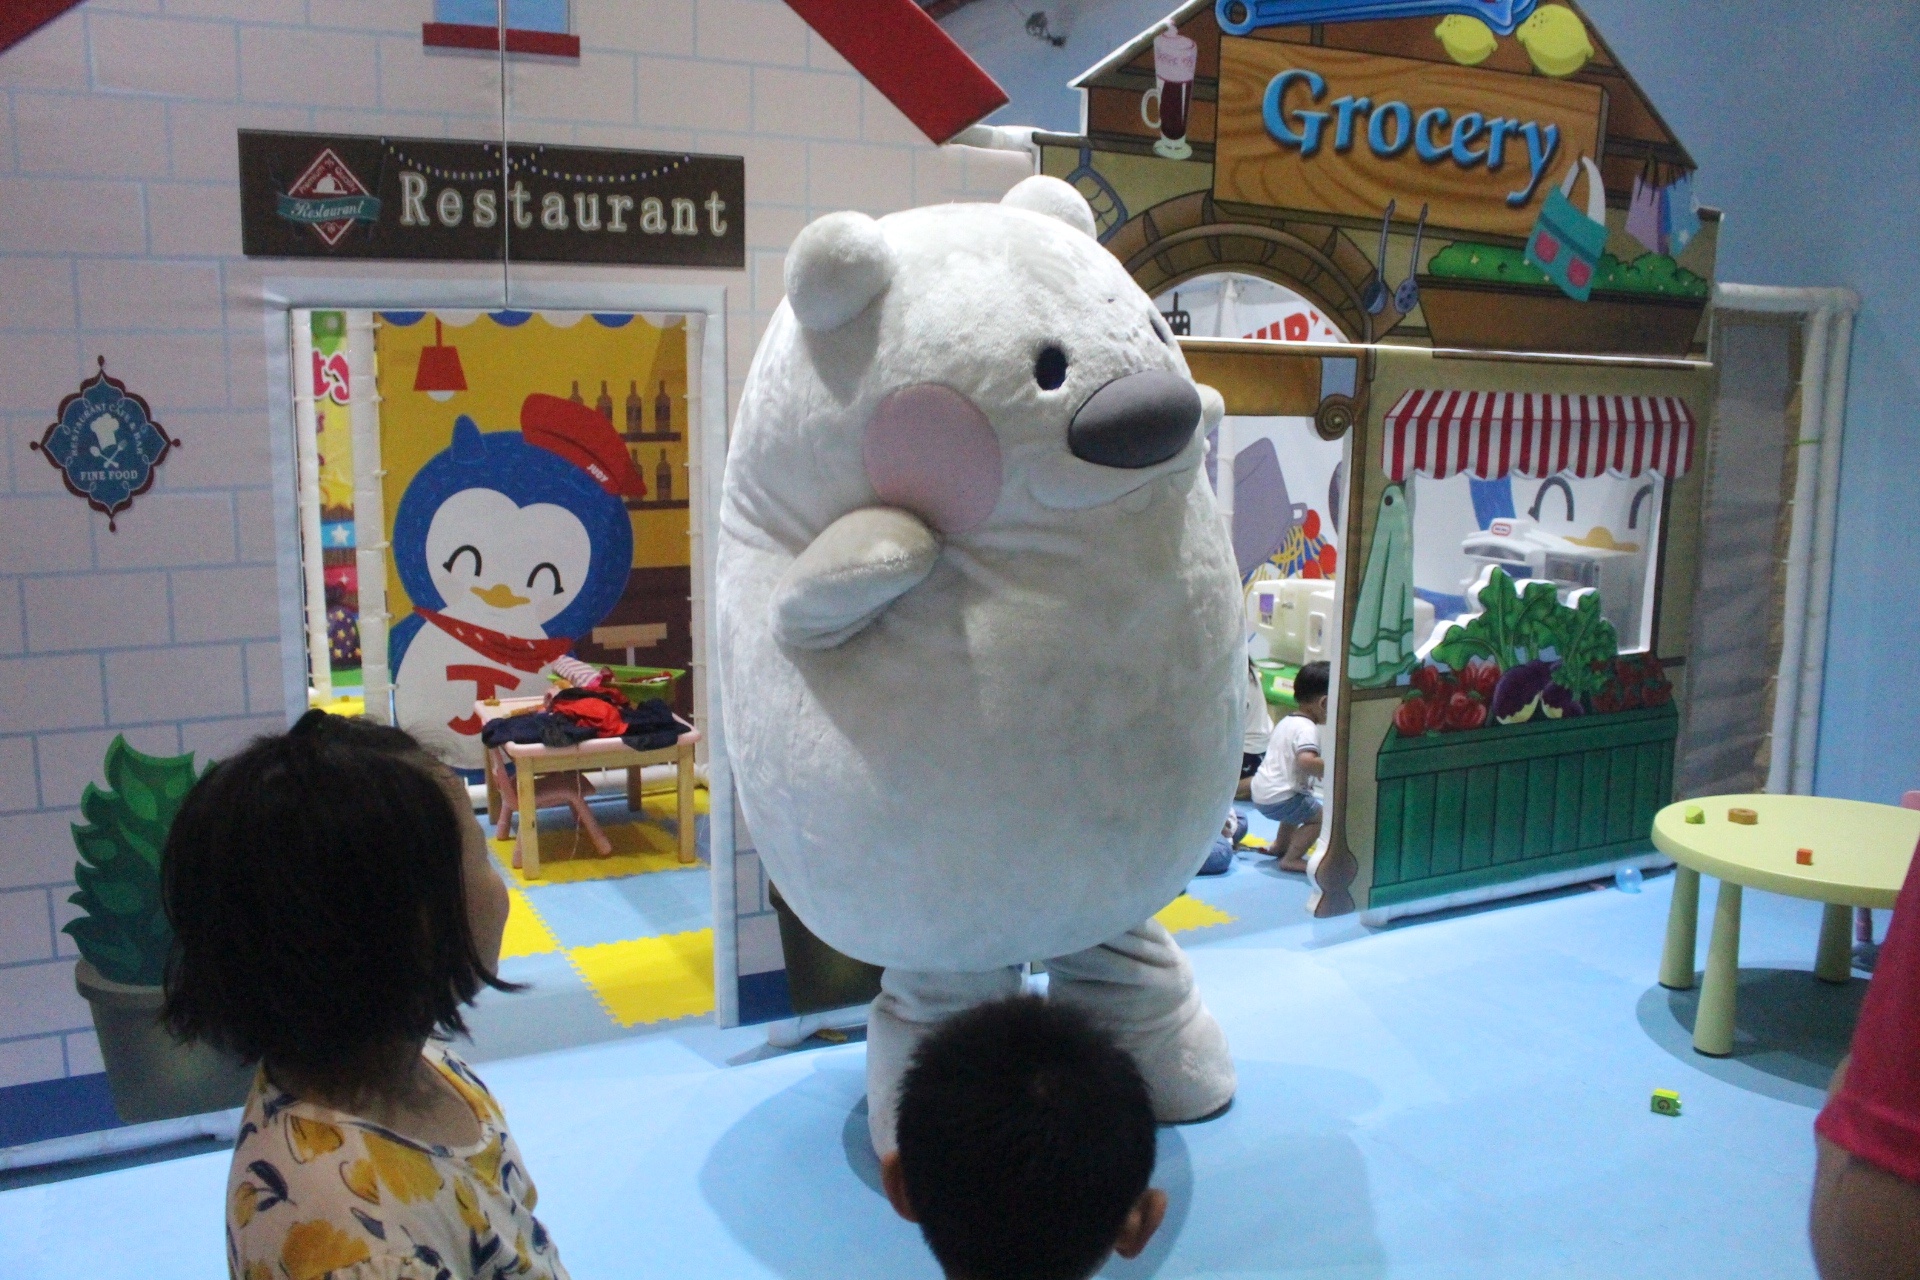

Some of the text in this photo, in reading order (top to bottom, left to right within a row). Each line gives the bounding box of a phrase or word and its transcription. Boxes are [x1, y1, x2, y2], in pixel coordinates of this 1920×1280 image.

[1261, 68, 1559, 206] Grocery
[290, 200, 365, 218] Restaurant
[400, 171, 728, 236] Restaurant
[70, 403, 106, 456] RESTAURANT
[80, 470, 138, 481] FINE FOOD
